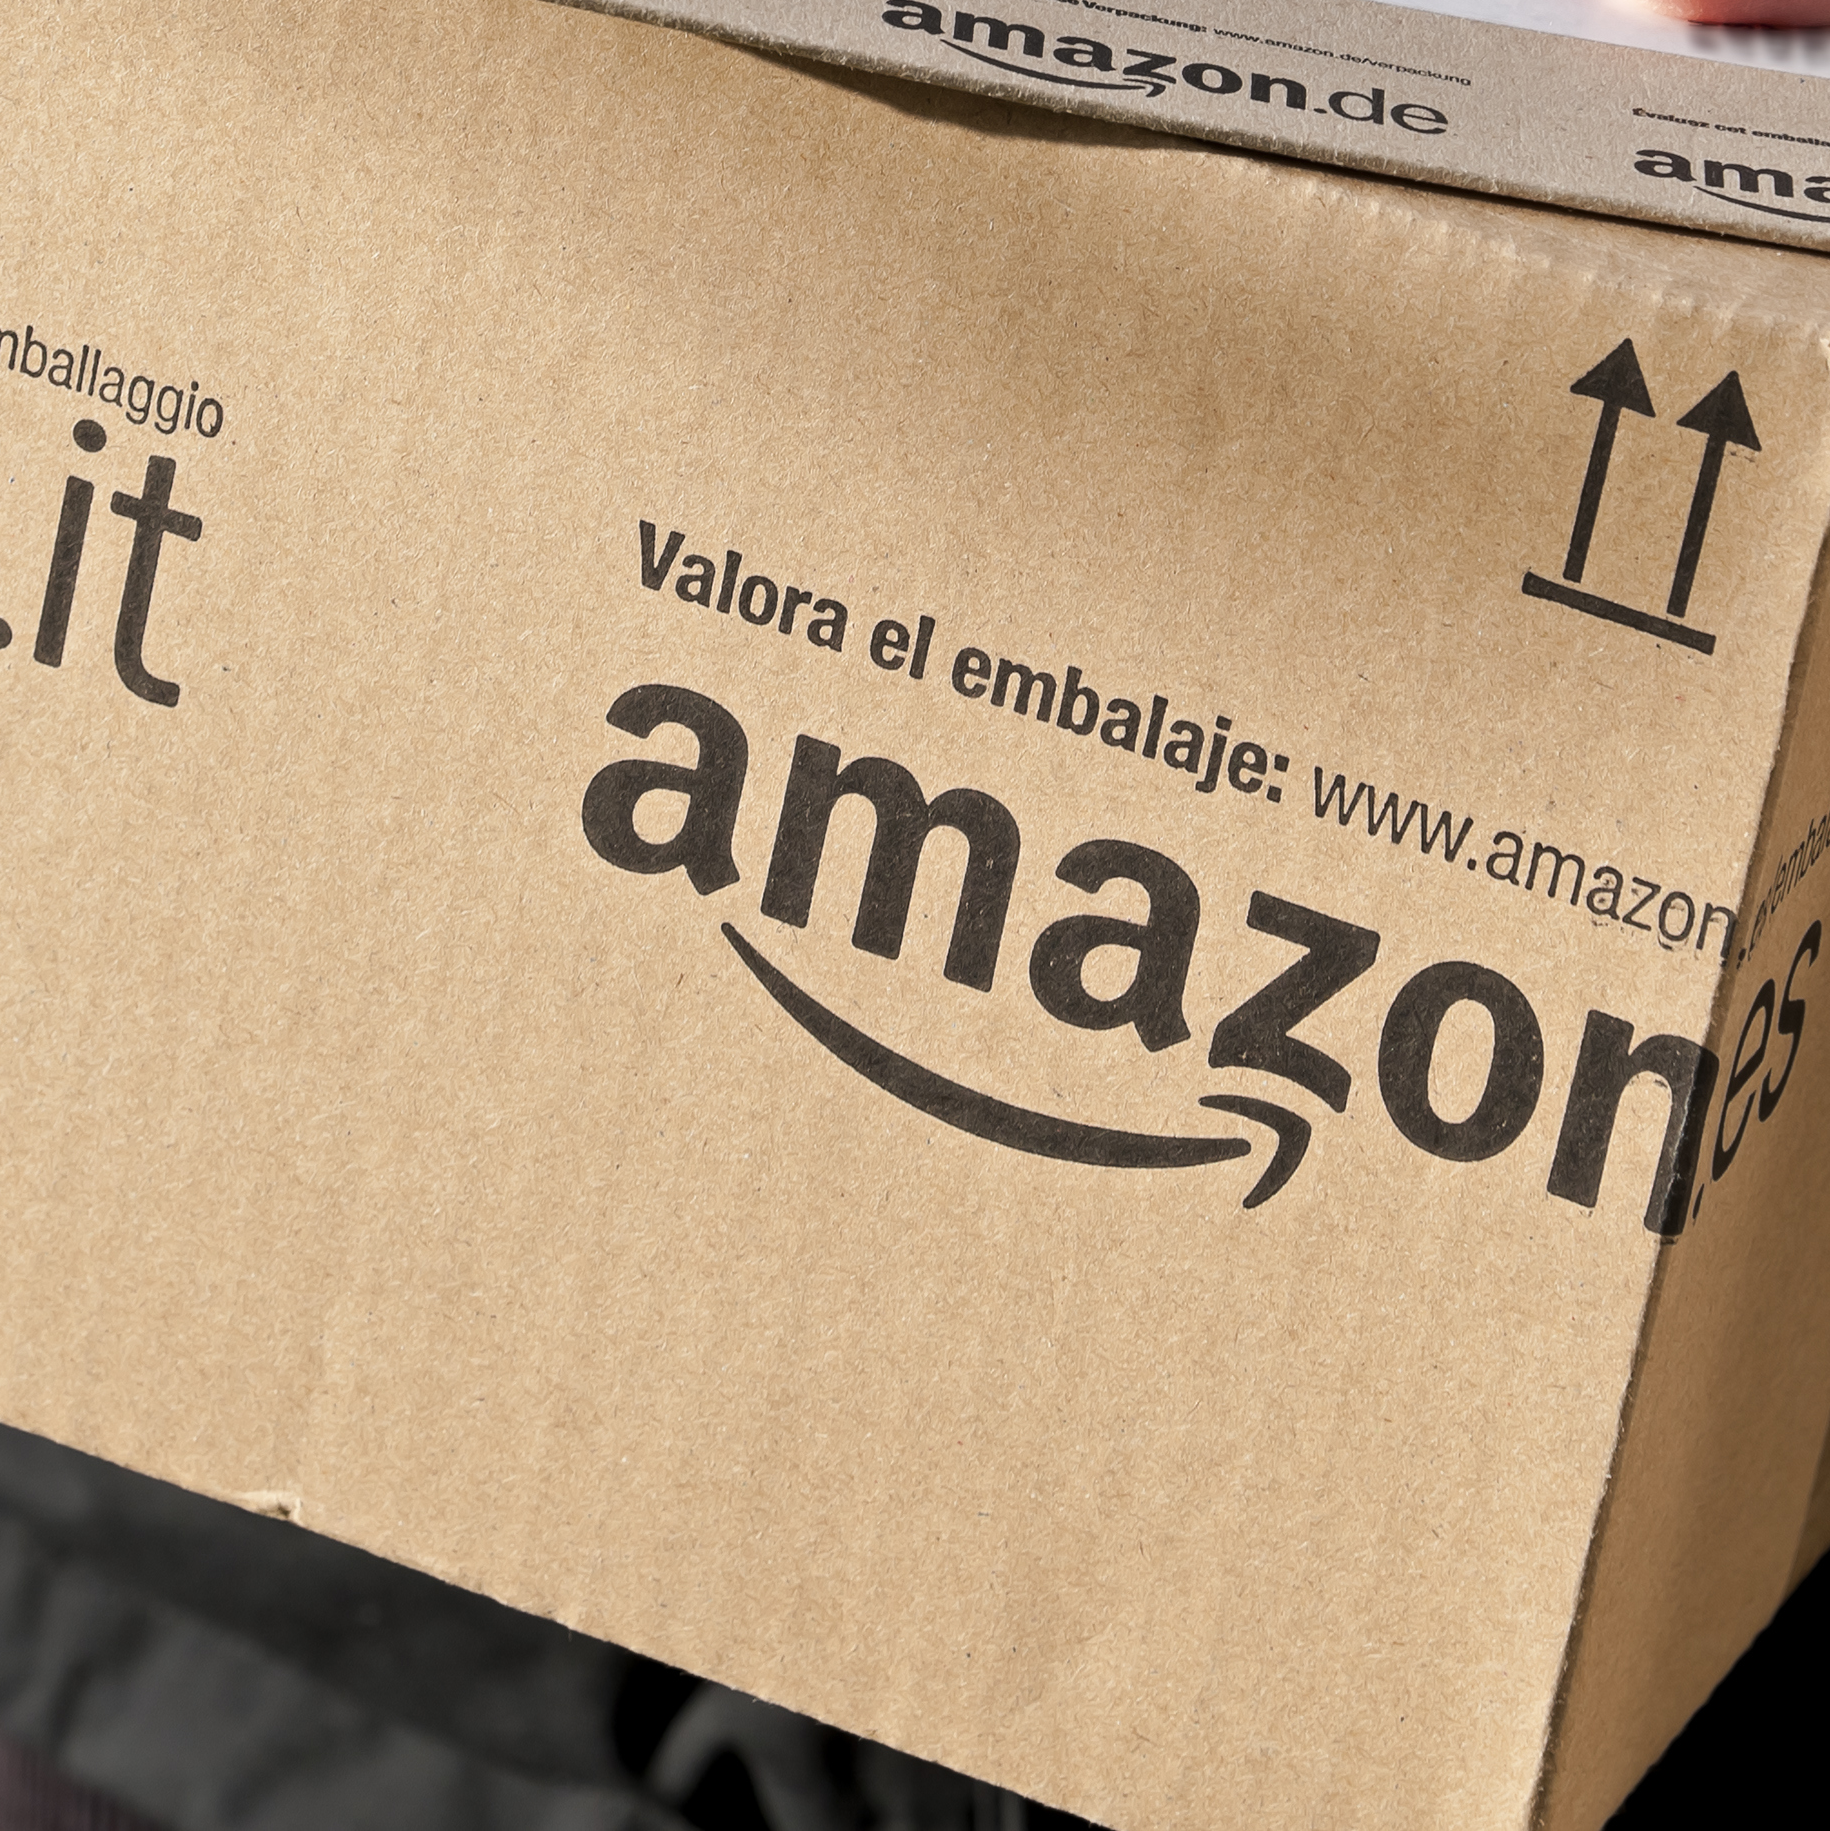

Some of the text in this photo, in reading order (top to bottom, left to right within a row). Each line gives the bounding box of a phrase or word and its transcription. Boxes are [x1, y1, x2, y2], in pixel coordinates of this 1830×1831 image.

[1081, 0, 1208, 33] Verpackung:
[1212, 27, 1472, 87] www.amazon.de/verpackung
[1714, 123, 1748, 136] cet
[638, 518, 847, 654] Valora
[869, 615, 934, 681] el
[950, 649, 1290, 803] embalaje:
[579, 681, 1823, 1238] amazon.es
